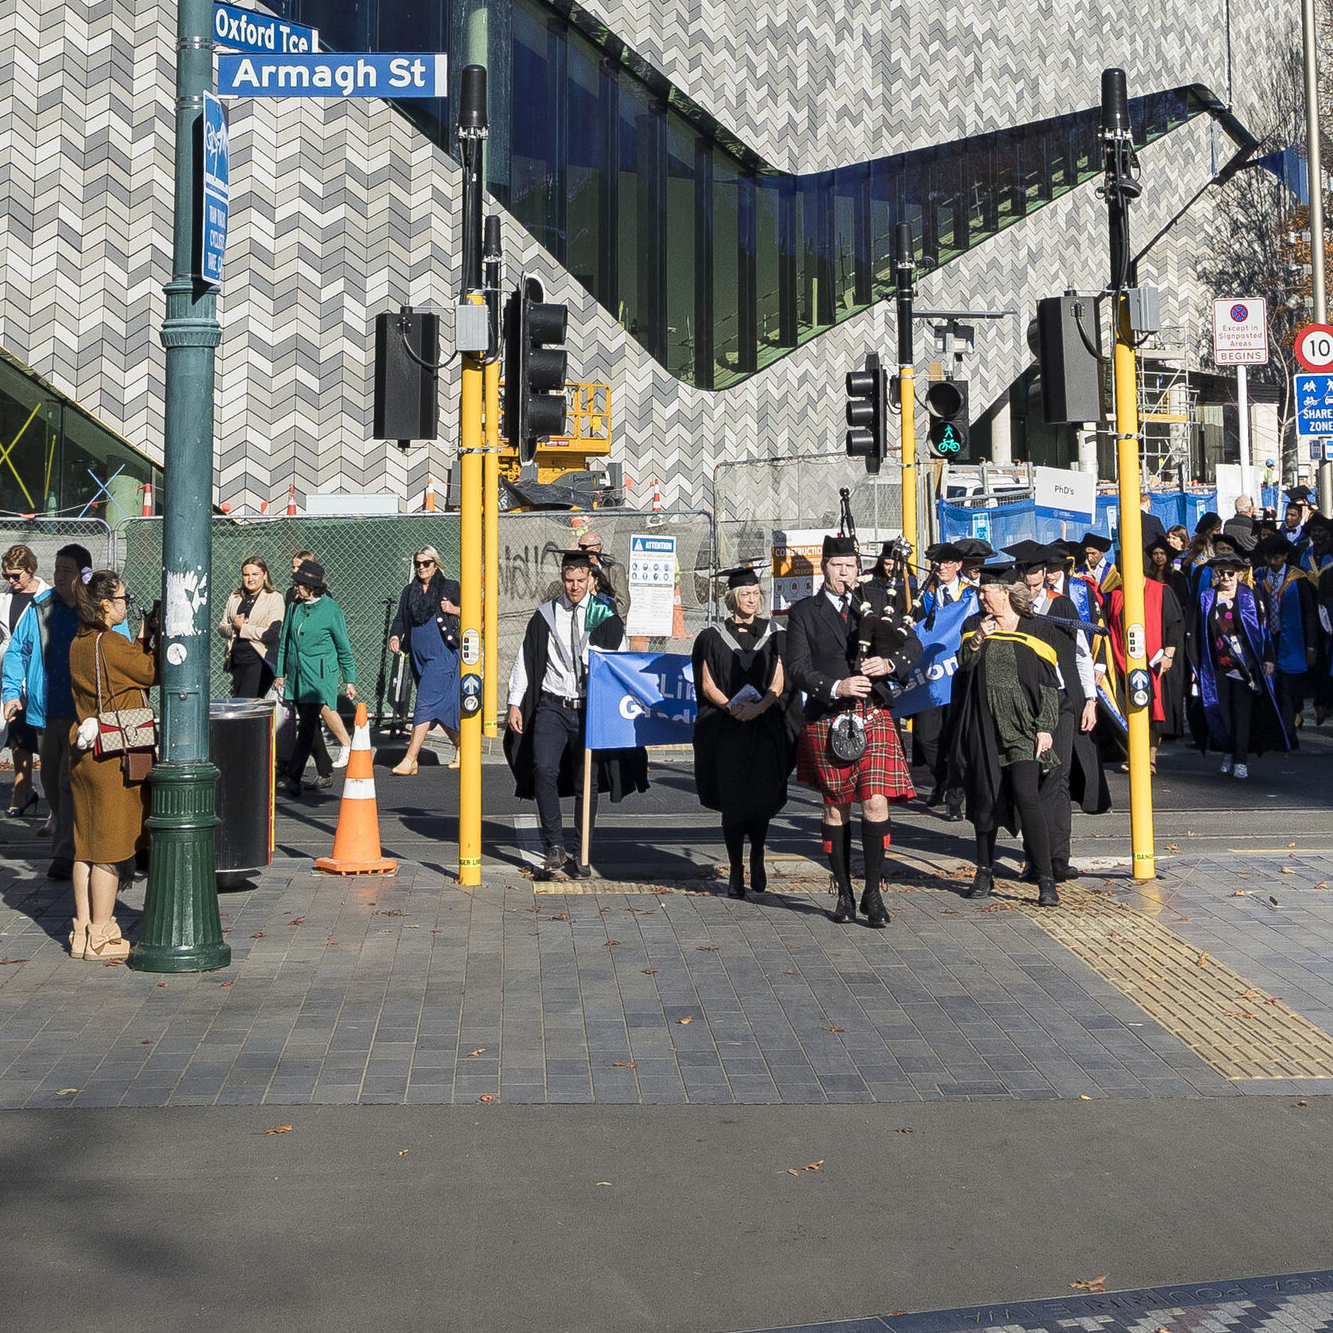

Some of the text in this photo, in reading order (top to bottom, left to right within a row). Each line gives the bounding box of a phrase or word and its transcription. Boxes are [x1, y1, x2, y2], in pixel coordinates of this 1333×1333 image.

[215, 8, 308, 53] Oxford Tce
[232, 58, 426, 96] Armagh St
[1222, 324, 1249, 332] Except
[1219, 332, 1262, 341] Signposted
[1310, 339, 1330, 357] 10
[1221, 351, 1262, 360] BEGINS
[1309, 421, 1333, 432] ZONE
[1054, 485, 1075, 496] PhD's
[775, 546, 823, 557] CONSTRUCTIO
